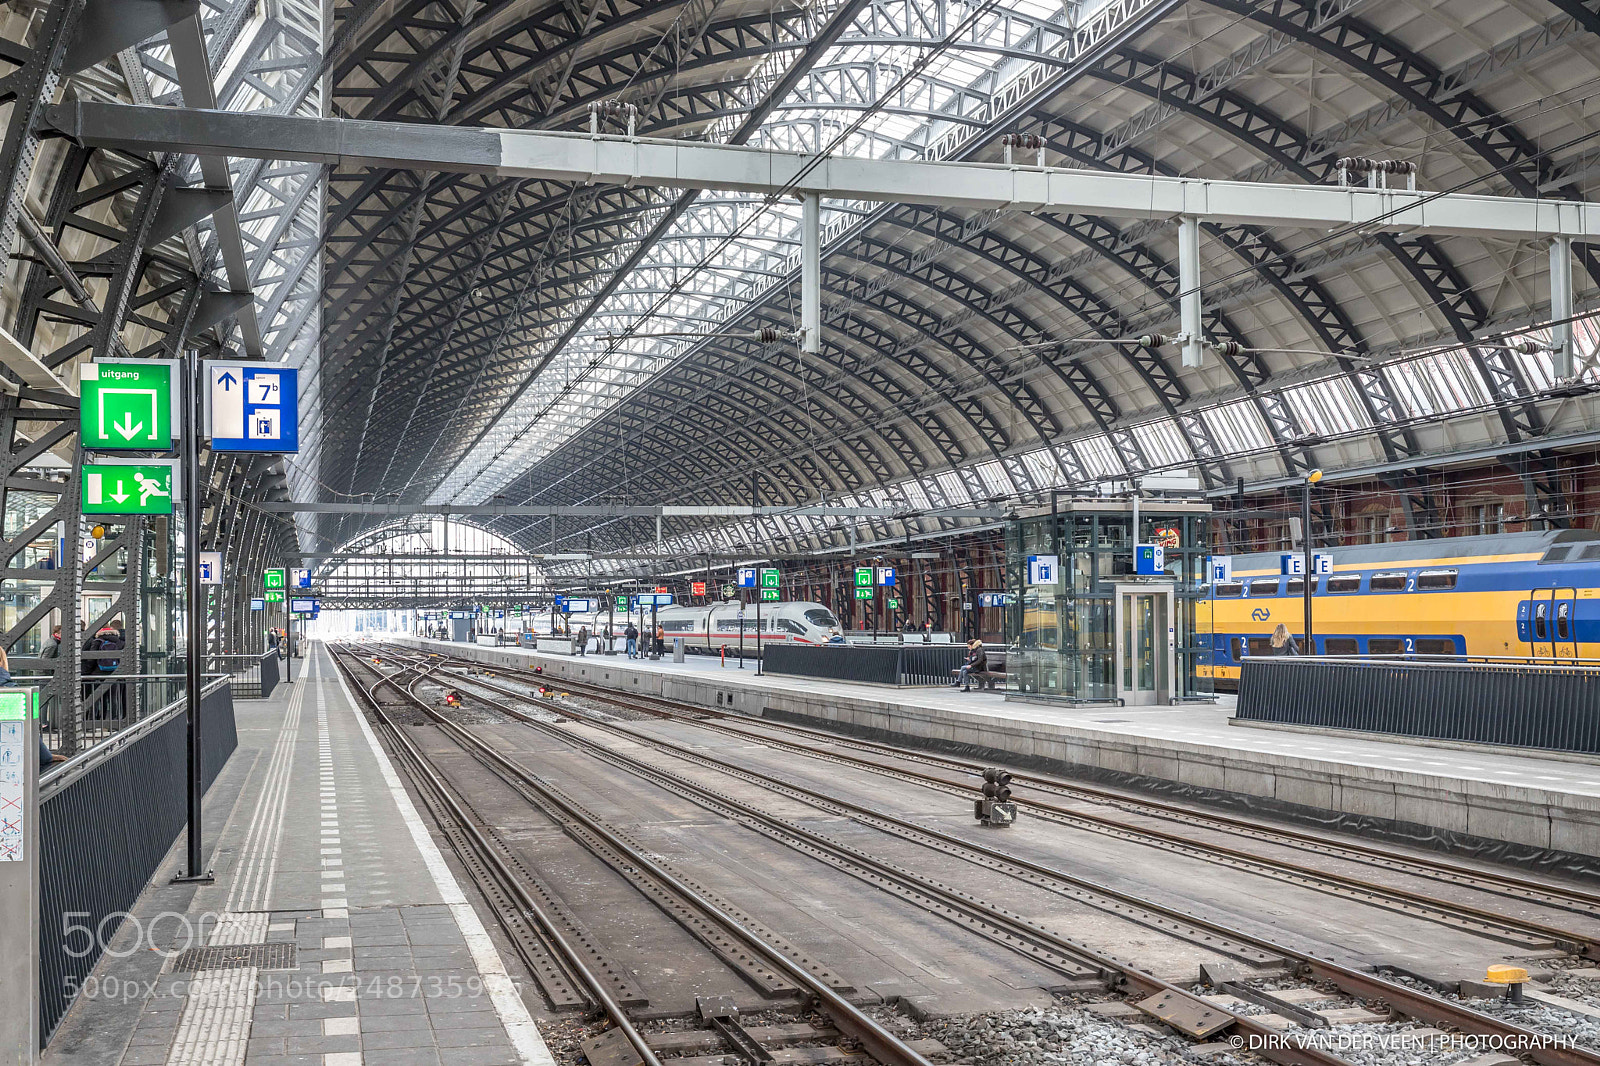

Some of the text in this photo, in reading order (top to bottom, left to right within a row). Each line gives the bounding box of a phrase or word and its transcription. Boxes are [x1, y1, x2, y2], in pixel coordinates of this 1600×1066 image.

[101, 370, 139, 380] uitgang
[1293, 561, 1300, 573] E
[1321, 561, 1328, 573] E
[1407, 579, 1414, 592] 2
[1242, 586, 1248, 598] 2
[1241, 636, 1247, 648] 2
[1405, 638, 1413, 652] 2
